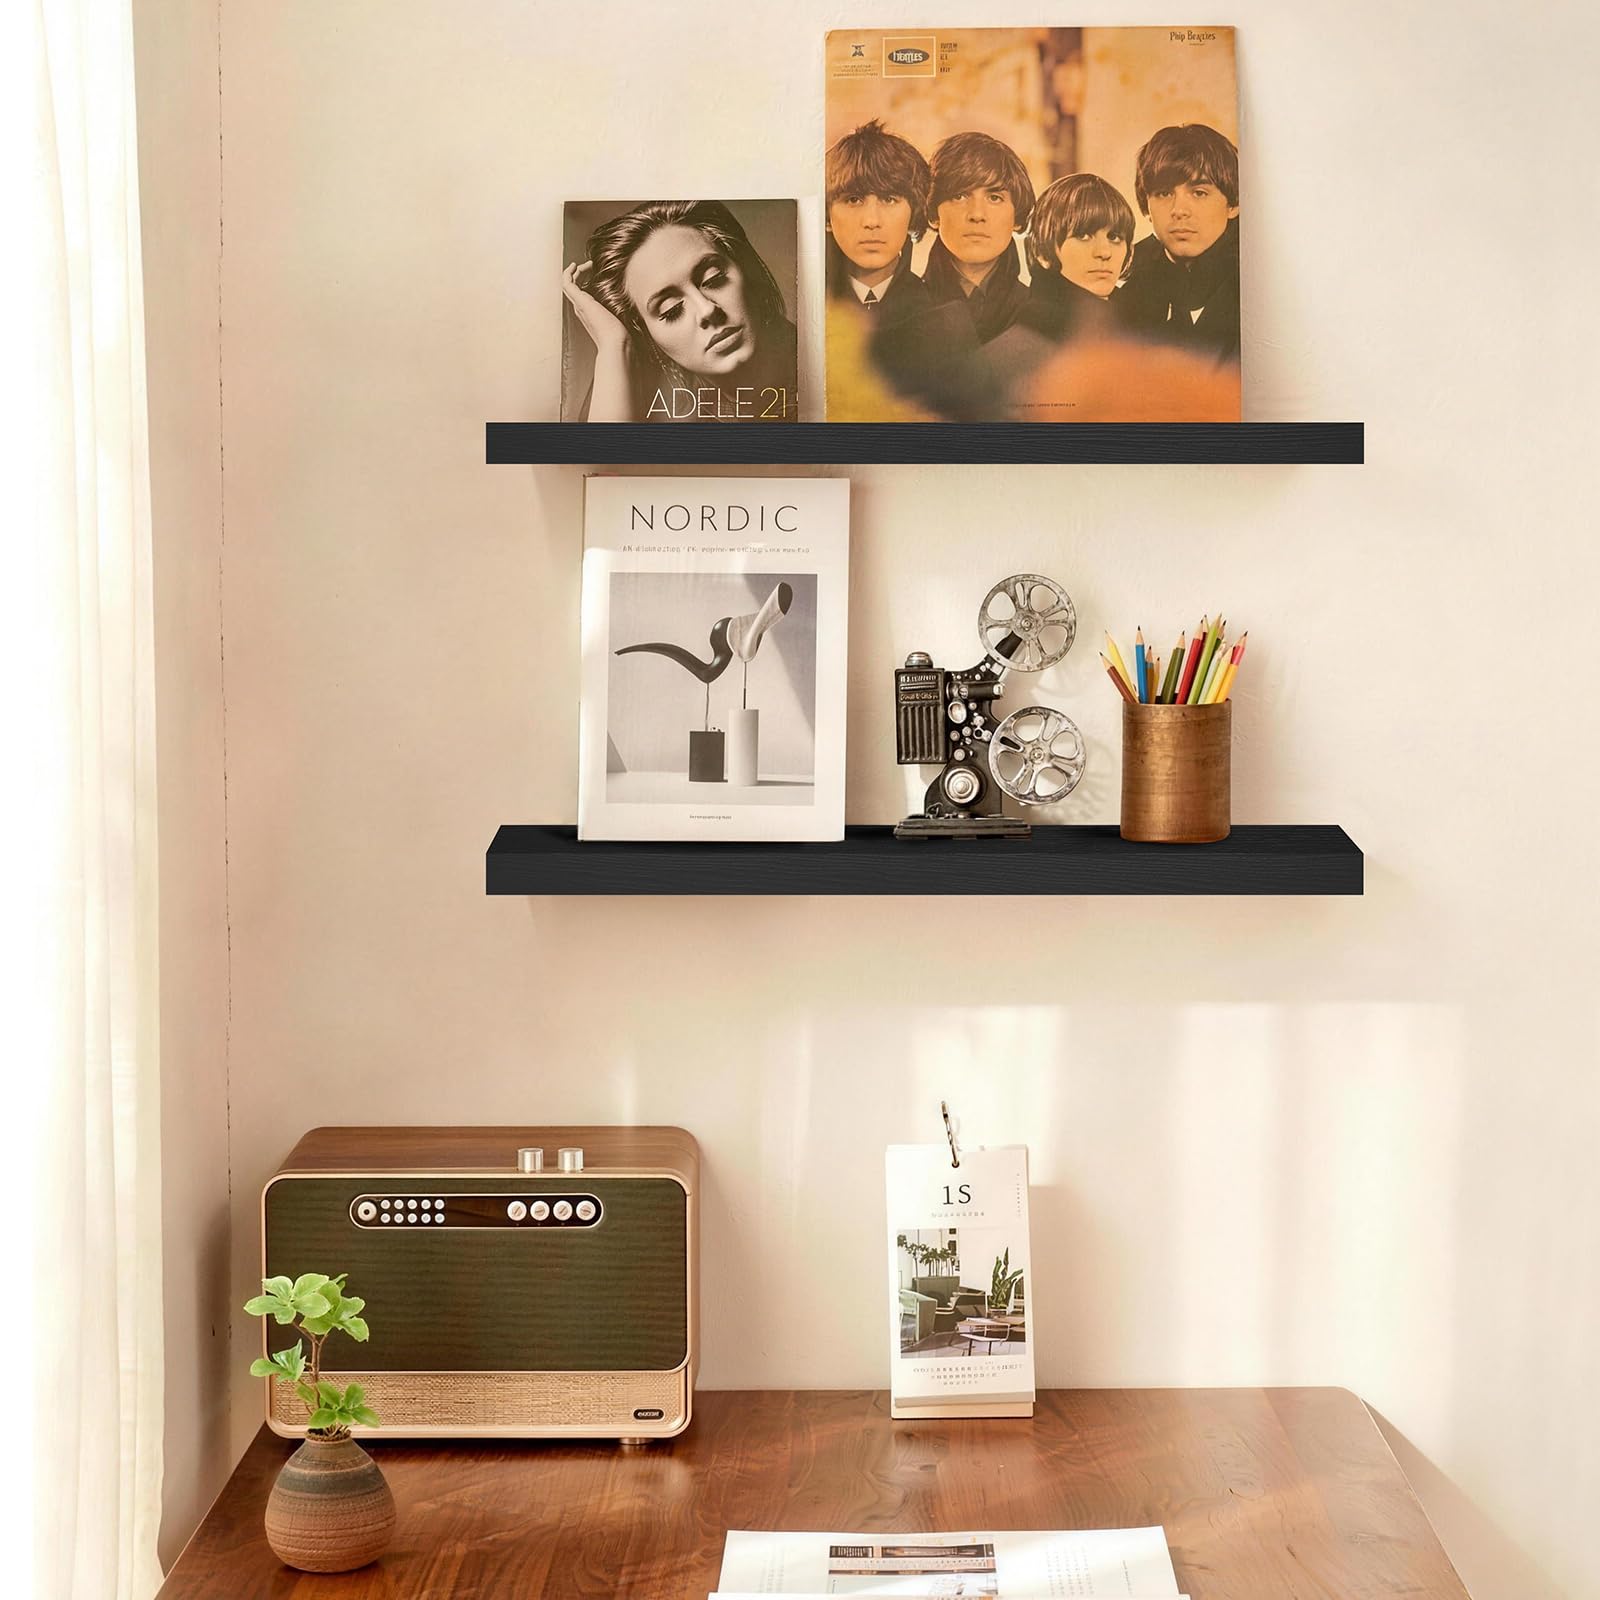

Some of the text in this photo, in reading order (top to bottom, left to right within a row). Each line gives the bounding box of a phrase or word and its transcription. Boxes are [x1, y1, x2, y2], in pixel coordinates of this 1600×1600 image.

[646, 387, 787, 419] ADELE 21
[630, 503, 800, 533] NORDIC
